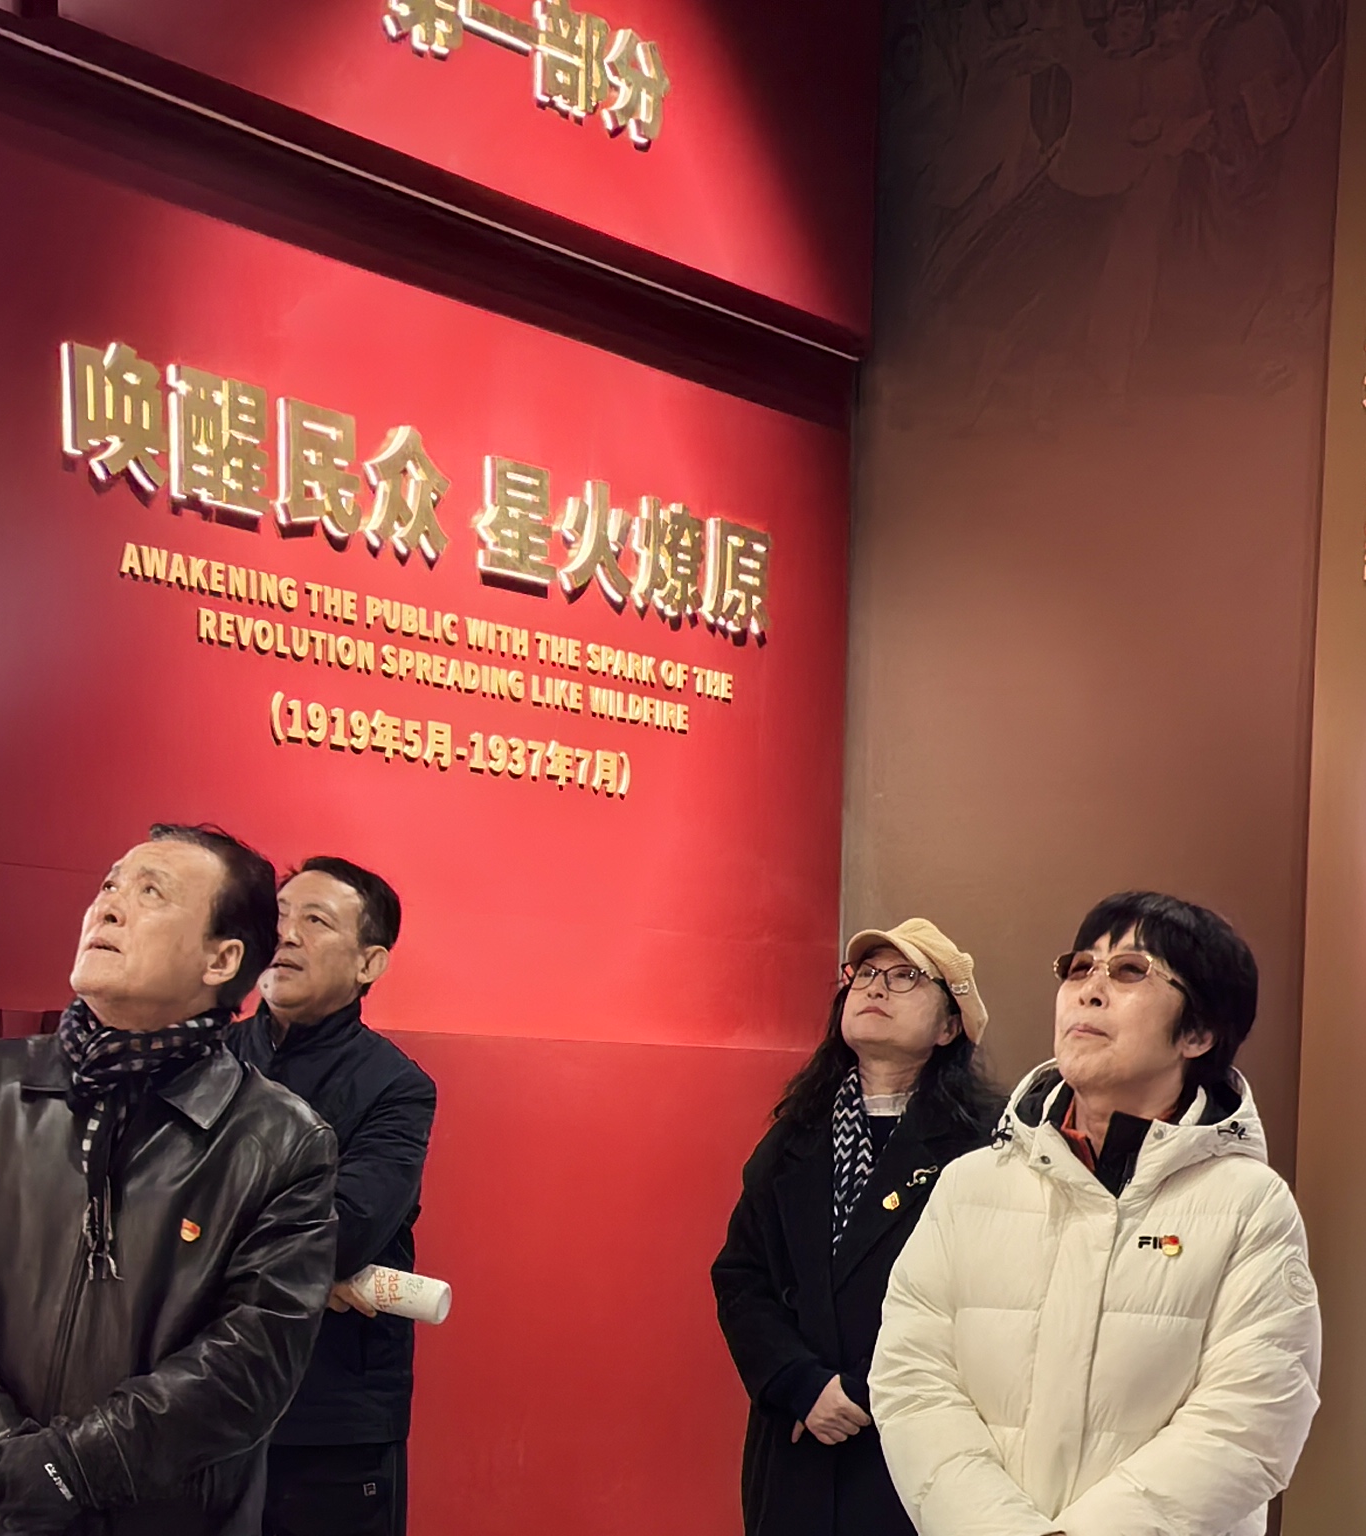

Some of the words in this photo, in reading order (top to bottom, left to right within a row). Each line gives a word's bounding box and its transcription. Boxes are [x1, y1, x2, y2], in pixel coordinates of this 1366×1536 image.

[61, 341, 449, 563] 唤醒民众
[476, 455, 774, 645] 星火燎原
[121, 543, 297, 611] AWAKENING
[307, 583, 359, 624] THE
[365, 596, 458, 643] PUBLIC
[465, 615, 530, 659] WITH
[535, 631, 581, 671] THE
[586, 642, 655, 685] SPARK
[661, 658, 688, 691] OF
[693, 664, 733, 702] THE
[198, 608, 375, 674] REVOLUTION
[381, 648, 524, 703] SPREADING
[530, 672, 583, 712] LIKE
[589, 683, 689, 733] WILDFIRE
